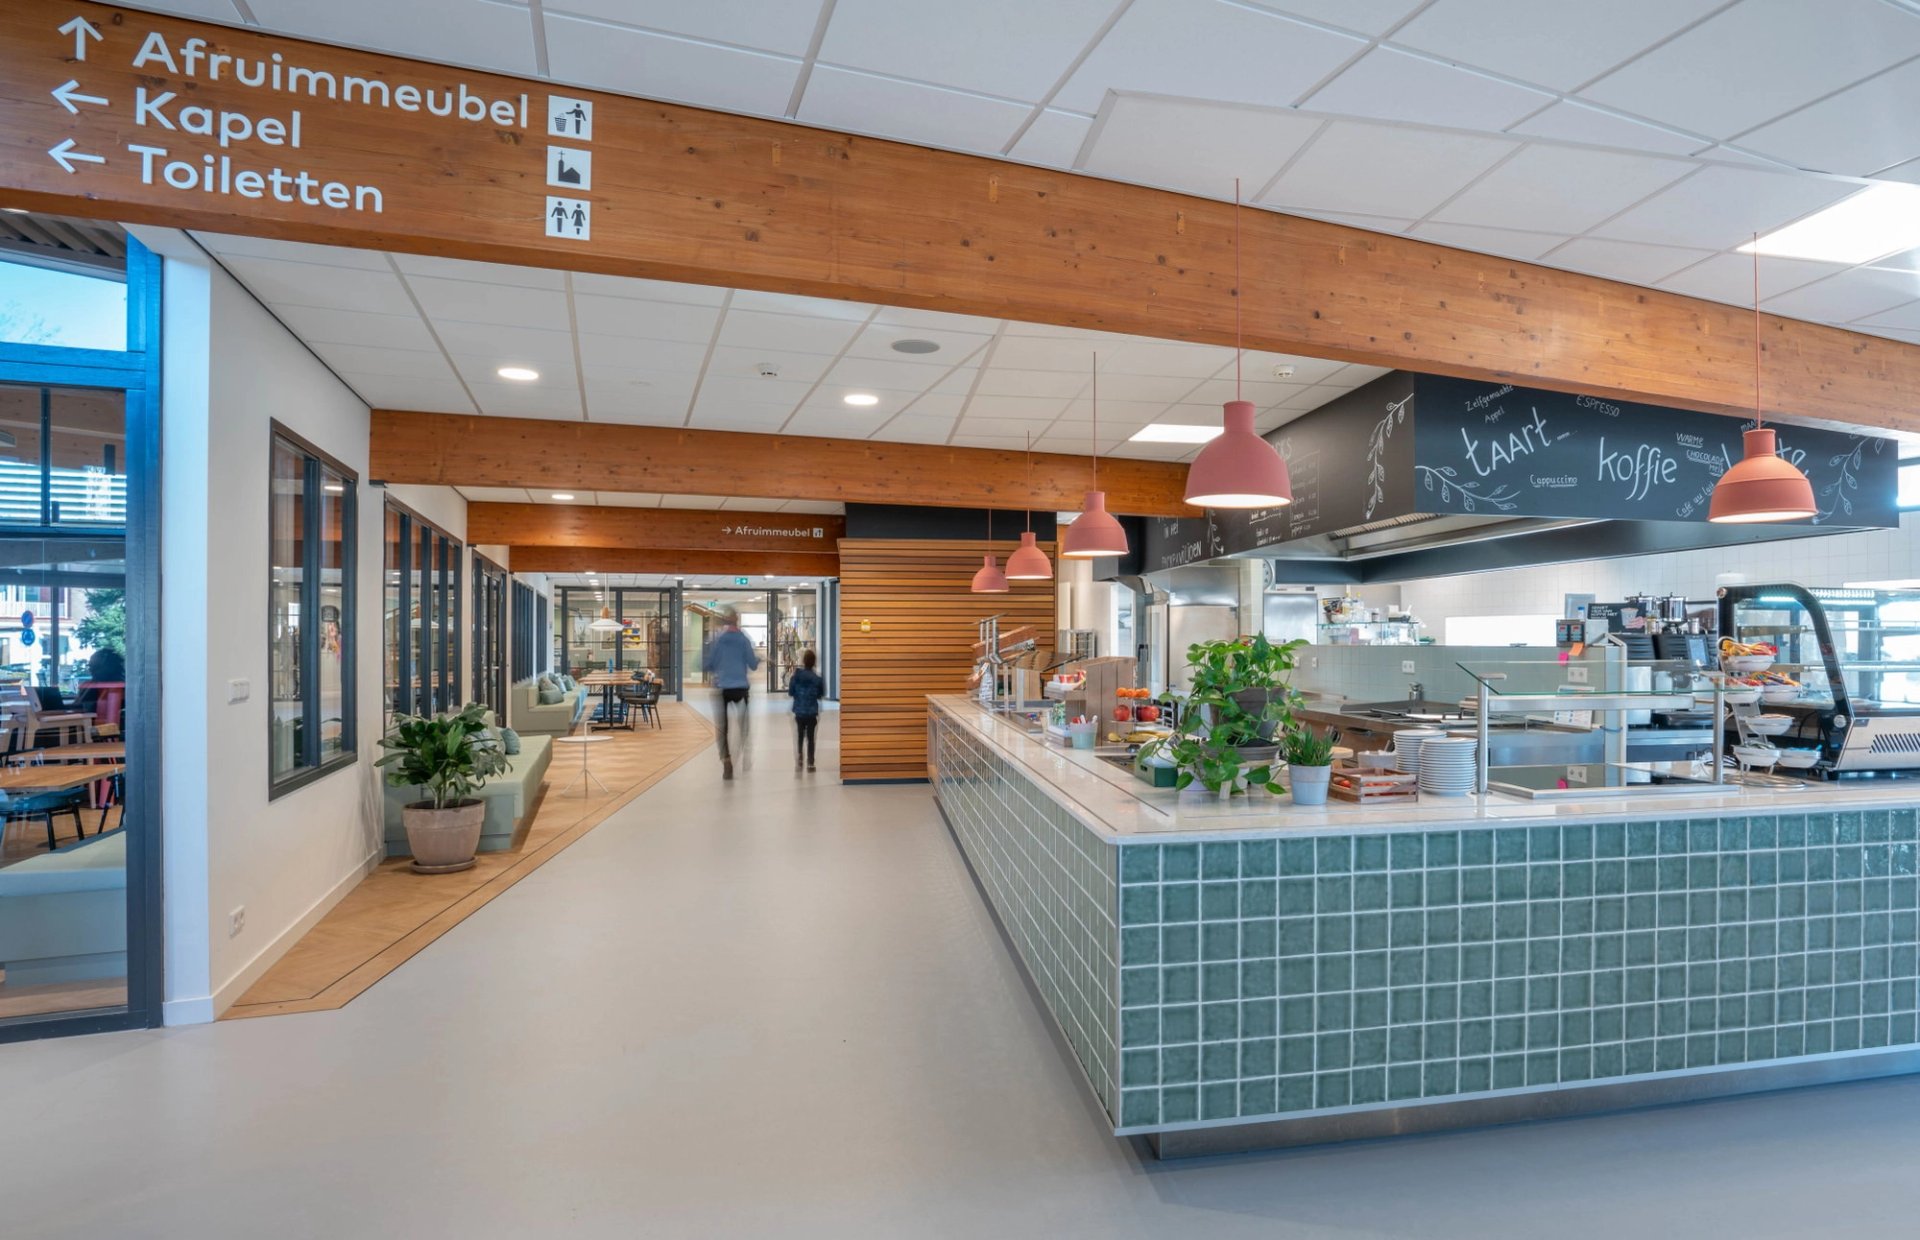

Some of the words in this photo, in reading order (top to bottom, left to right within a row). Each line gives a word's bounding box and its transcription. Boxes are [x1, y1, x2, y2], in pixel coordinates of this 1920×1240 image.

[132, 31, 528, 128] Afruimmeubel
[136, 87, 300, 147] Kapel
[128, 144, 383, 213] Toiletten
[1598, 436, 1677, 500] koffie
[735, 526, 810, 537] Afruimmeubel
